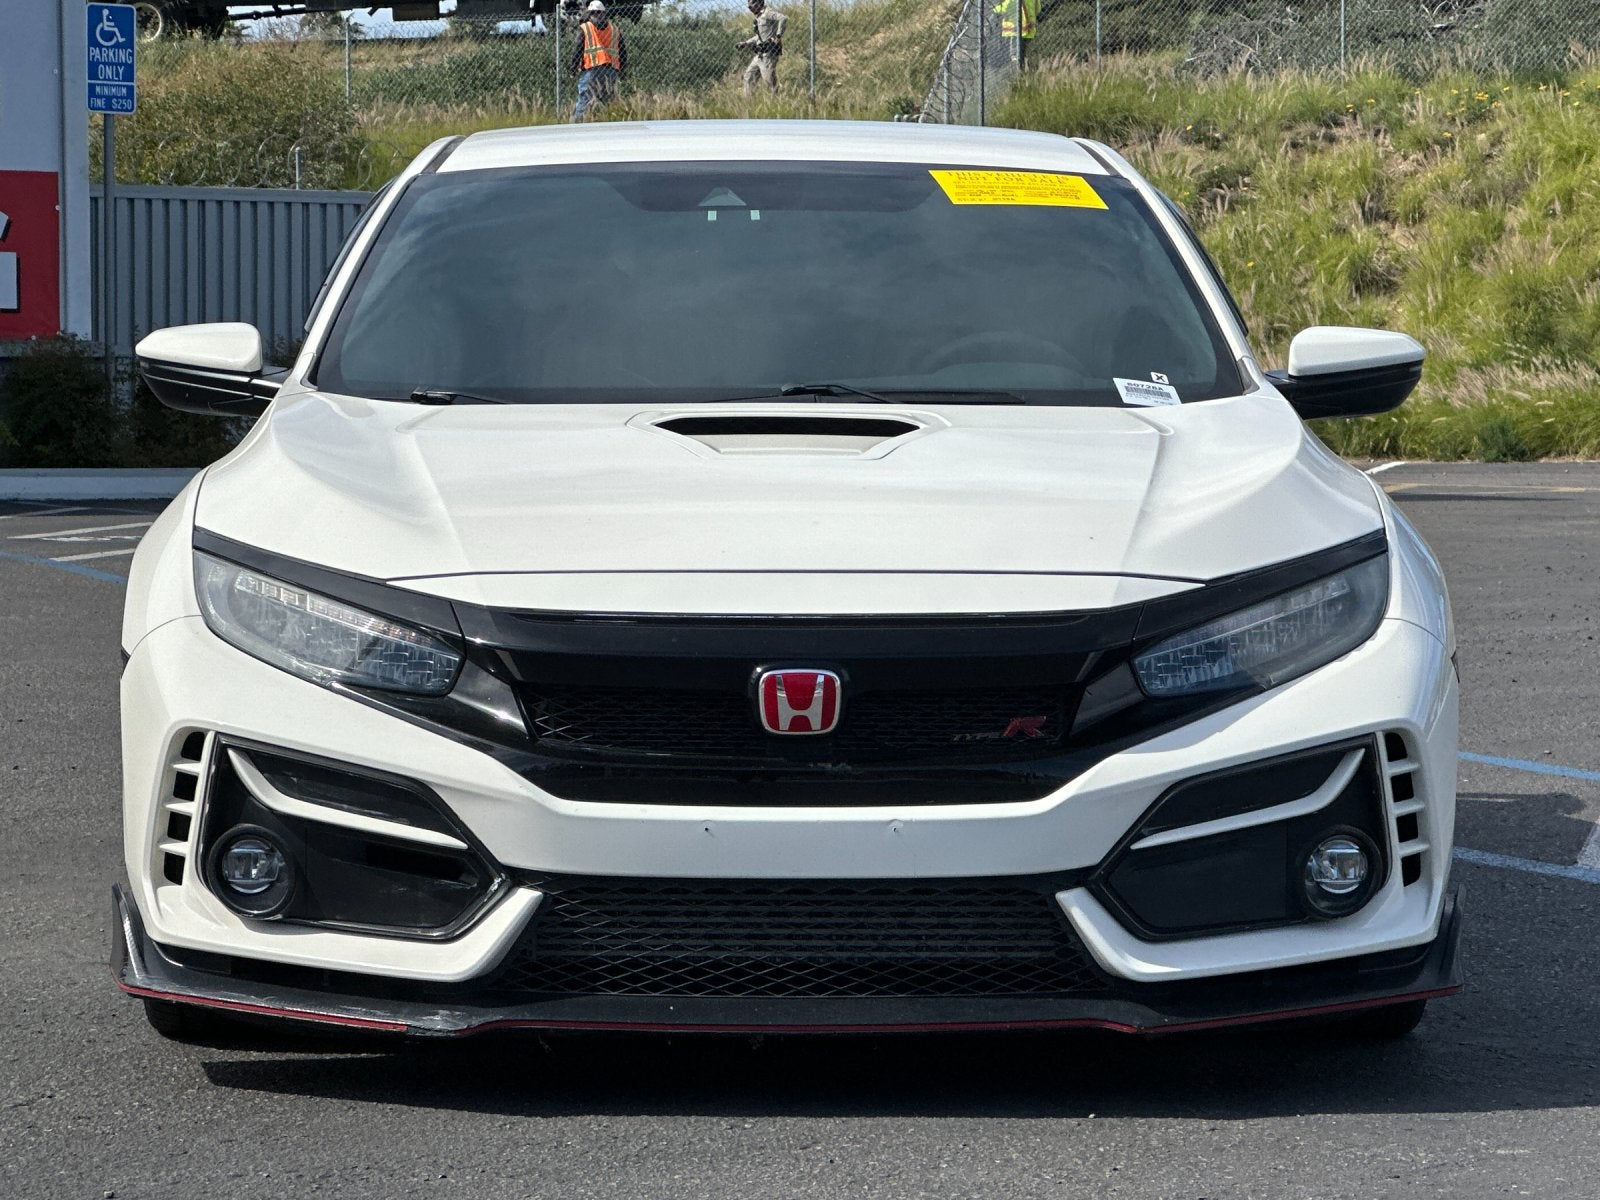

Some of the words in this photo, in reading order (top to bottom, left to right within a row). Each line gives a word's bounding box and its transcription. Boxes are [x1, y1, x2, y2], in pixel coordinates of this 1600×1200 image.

[89, 47, 133, 64] PARKING
[98, 64, 125, 80] ONLY
[95, 85, 127, 96] MINIMUM
[90, 98, 106, 109] FINE
[111, 98, 132, 110] $250
[1002, 716, 1047, 738] R
